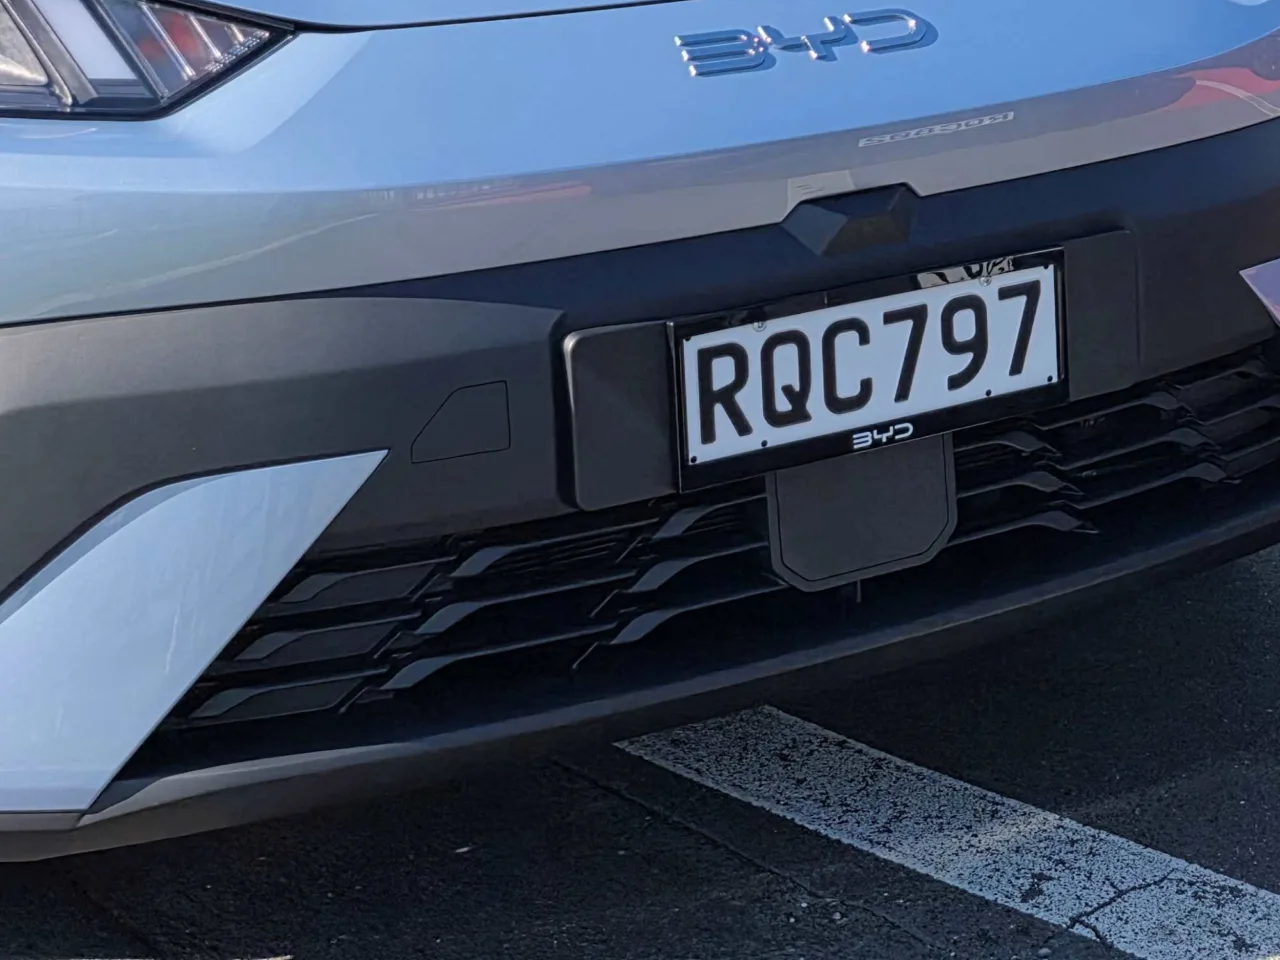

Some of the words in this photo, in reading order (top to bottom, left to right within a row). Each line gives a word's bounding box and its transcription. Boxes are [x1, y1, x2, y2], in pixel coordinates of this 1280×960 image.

[674, 9, 930, 76] BYD
[696, 279, 1042, 445] RQC797
[852, 422, 914, 450] BYD
